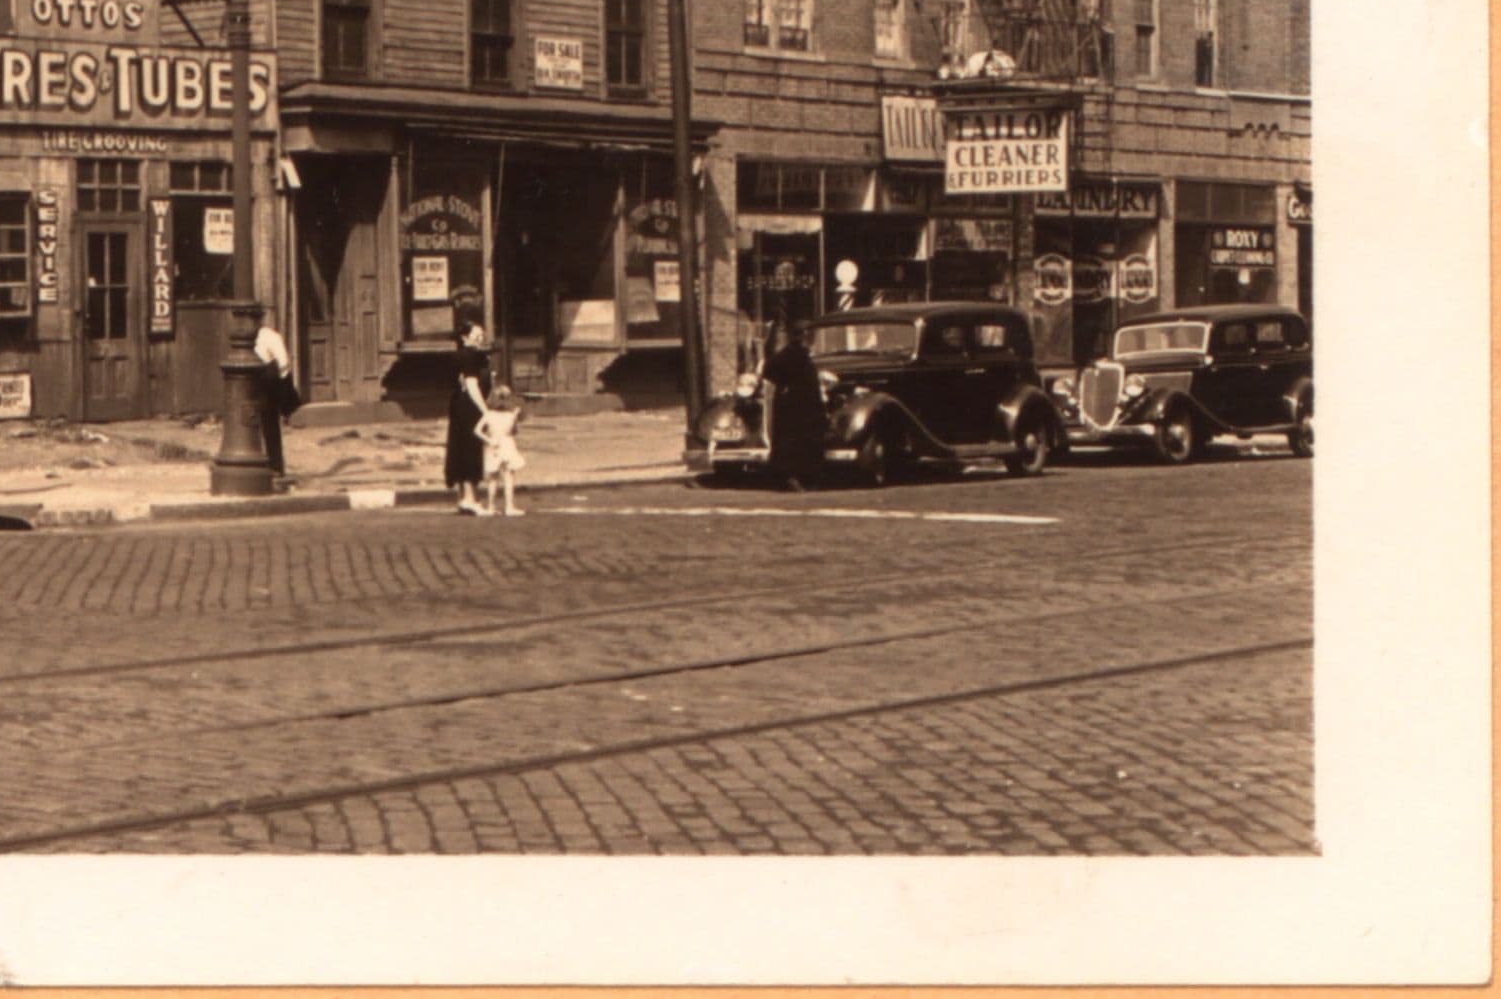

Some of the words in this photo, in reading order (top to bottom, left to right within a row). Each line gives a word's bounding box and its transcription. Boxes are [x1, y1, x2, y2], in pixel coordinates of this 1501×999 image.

[106, 47, 270, 115] TUBES
[956, 111, 1061, 141] TAILOR
[42, 132, 79, 151] TIRE
[955, 144, 1060, 167] CLEANER
[958, 169, 1062, 188] FURRIERS
[37, 190, 58, 302] SERVICE
[1226, 230, 1259, 248] ROXY
[151, 200, 170, 317] WILLARD
